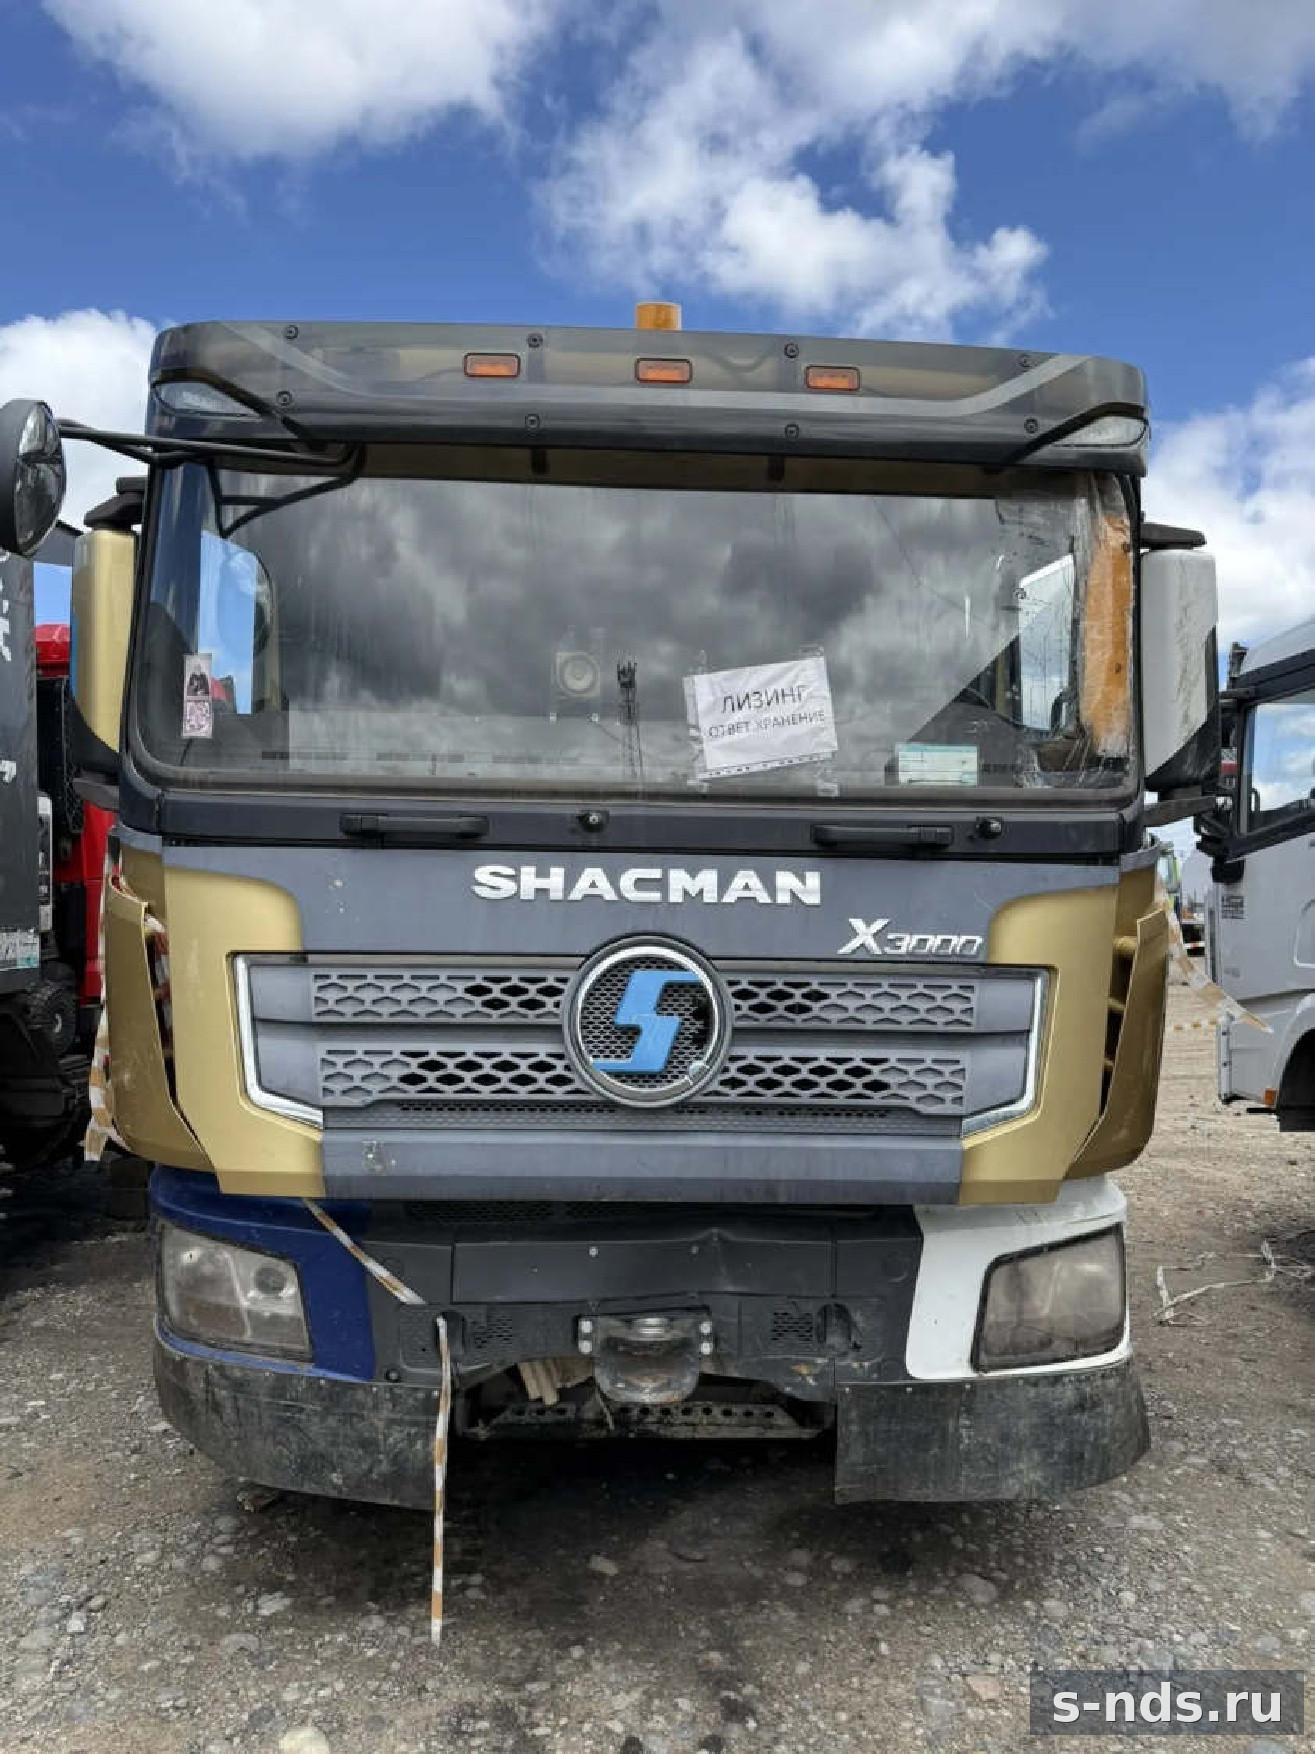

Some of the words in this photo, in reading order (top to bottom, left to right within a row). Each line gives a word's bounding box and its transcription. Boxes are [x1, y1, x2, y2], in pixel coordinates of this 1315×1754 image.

[722, 685, 807, 713] ЛИЗИНГ
[473, 865, 821, 905] SHACMAN
[837, 918, 983, 955] X3000
